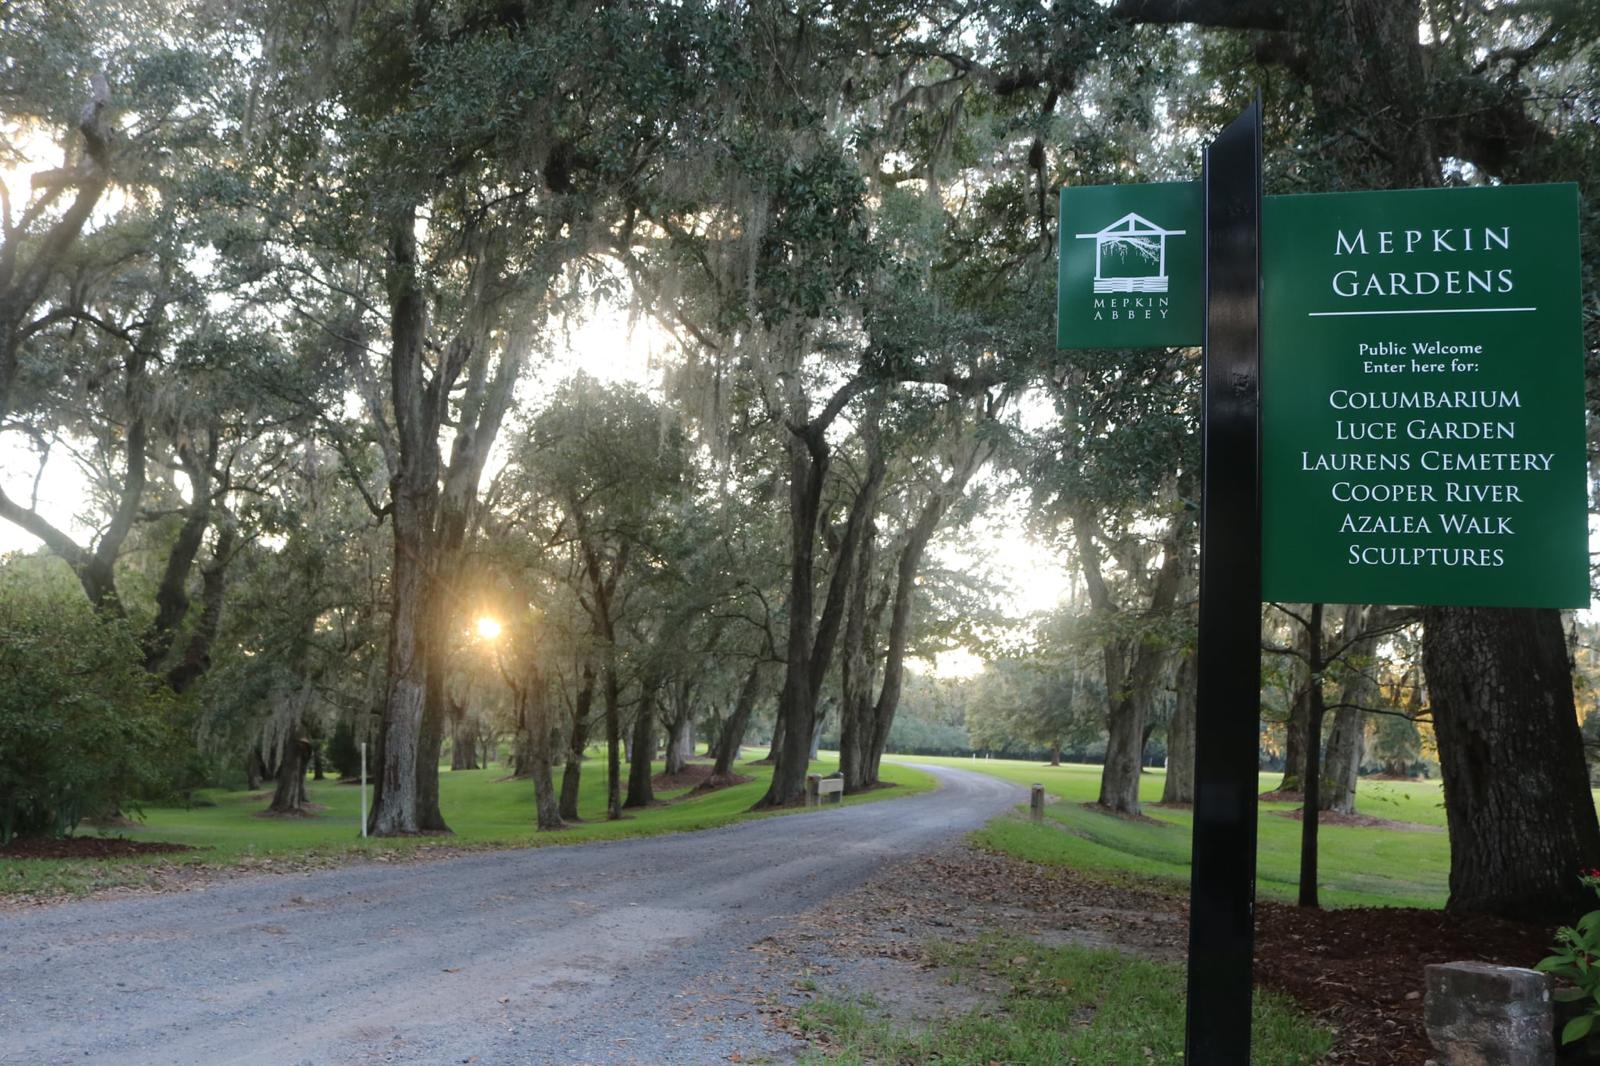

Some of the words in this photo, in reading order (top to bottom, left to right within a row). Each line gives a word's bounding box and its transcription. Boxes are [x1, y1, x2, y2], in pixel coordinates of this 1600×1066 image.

[1335, 226, 1510, 256] MEPKIN
[1332, 269, 1514, 298] GARDENS
[1093, 297, 1169, 308] MEPKIN
[1093, 309, 1169, 320] ABBEY
[1359, 341, 1407, 356] Public
[1412, 341, 1483, 355] Welcome
[1363, 360, 1405, 374] Enter
[1411, 359, 1445, 373] here
[1451, 358, 1479, 373] for:
[1329, 389, 1521, 410] COLUMBARIUM
[1336, 419, 1397, 440] LUCE
[1406, 419, 1516, 440] GARDEN
[1301, 450, 1411, 472] LAURENS
[1420, 450, 1555, 472] CEMETERY
[1331, 481, 1438, 503] COOPER
[1446, 481, 1523, 503] RIVER
[1339, 513, 1432, 534] AZALEA
[1438, 513, 1515, 534] WALK
[1348, 544, 1504, 567] SCULPTURES
